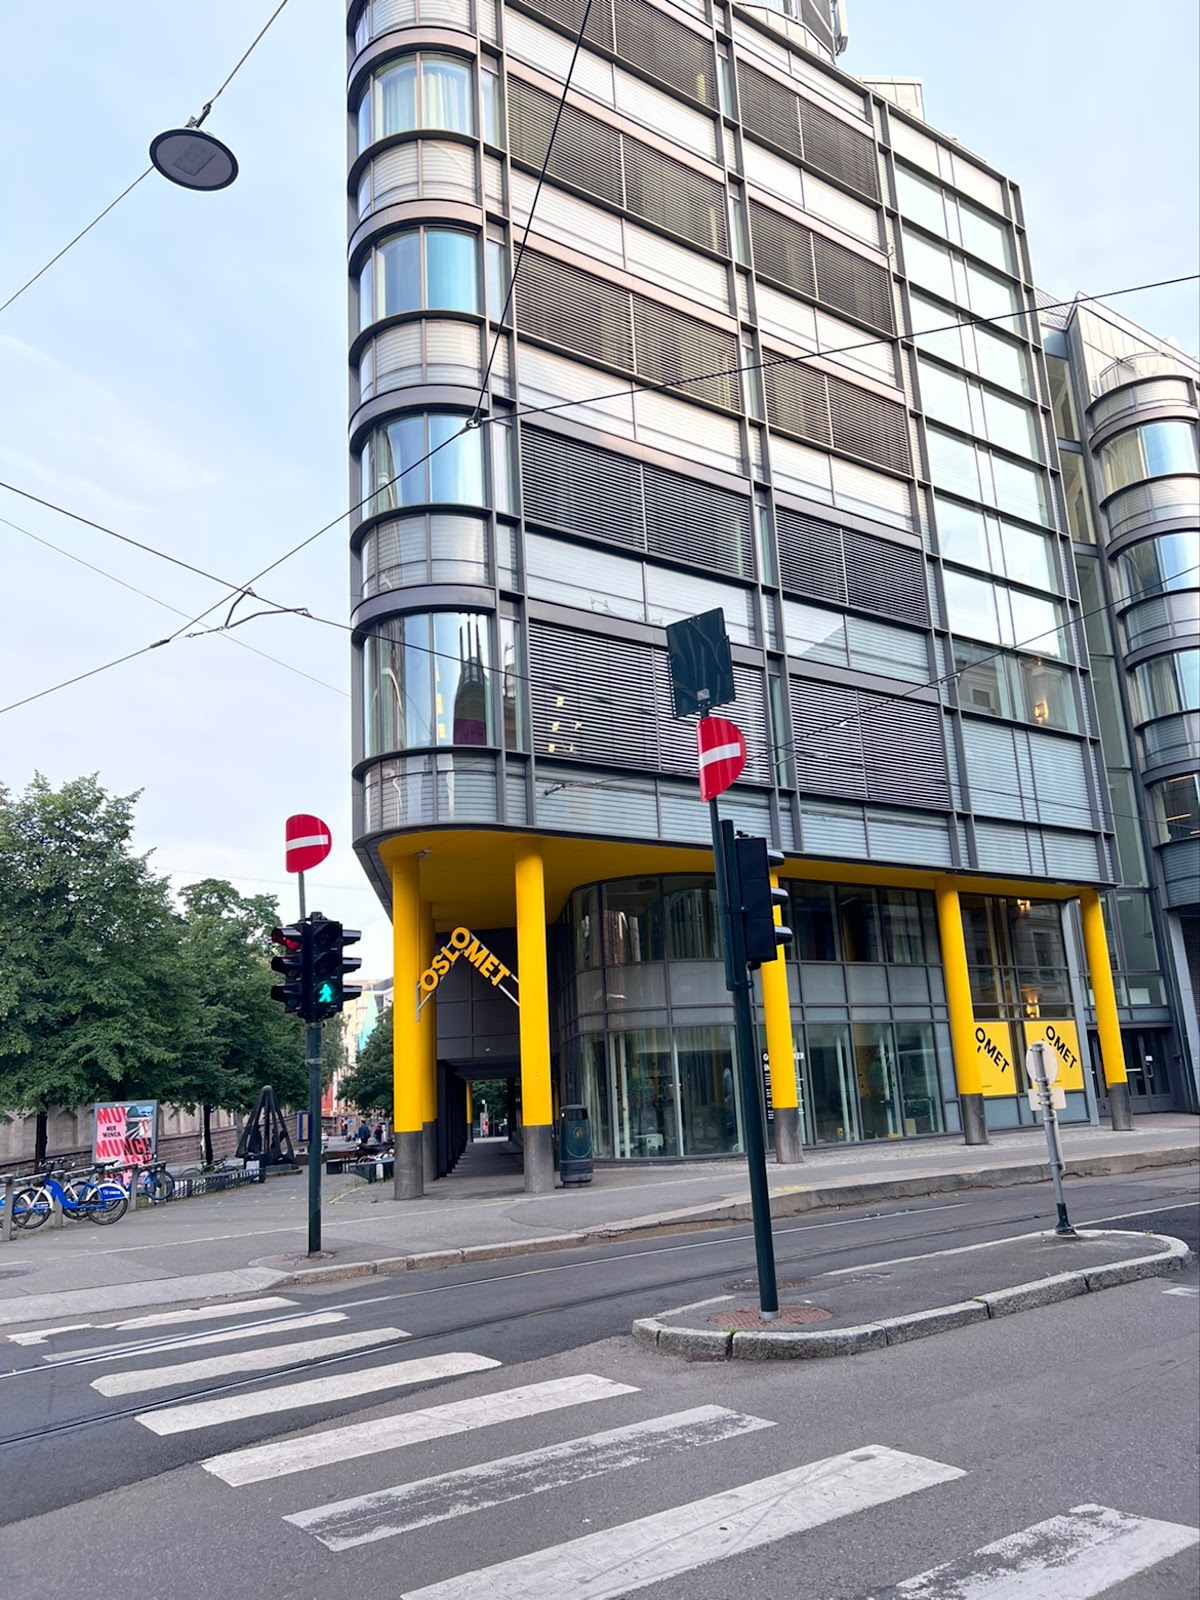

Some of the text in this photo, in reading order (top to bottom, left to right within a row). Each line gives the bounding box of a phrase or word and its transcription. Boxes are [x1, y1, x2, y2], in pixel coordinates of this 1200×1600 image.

[975, 1027, 1010, 1073] OMET
[1042, 1025, 1078, 1069] OMET
[96, 1137, 152, 1158] MUNCH
